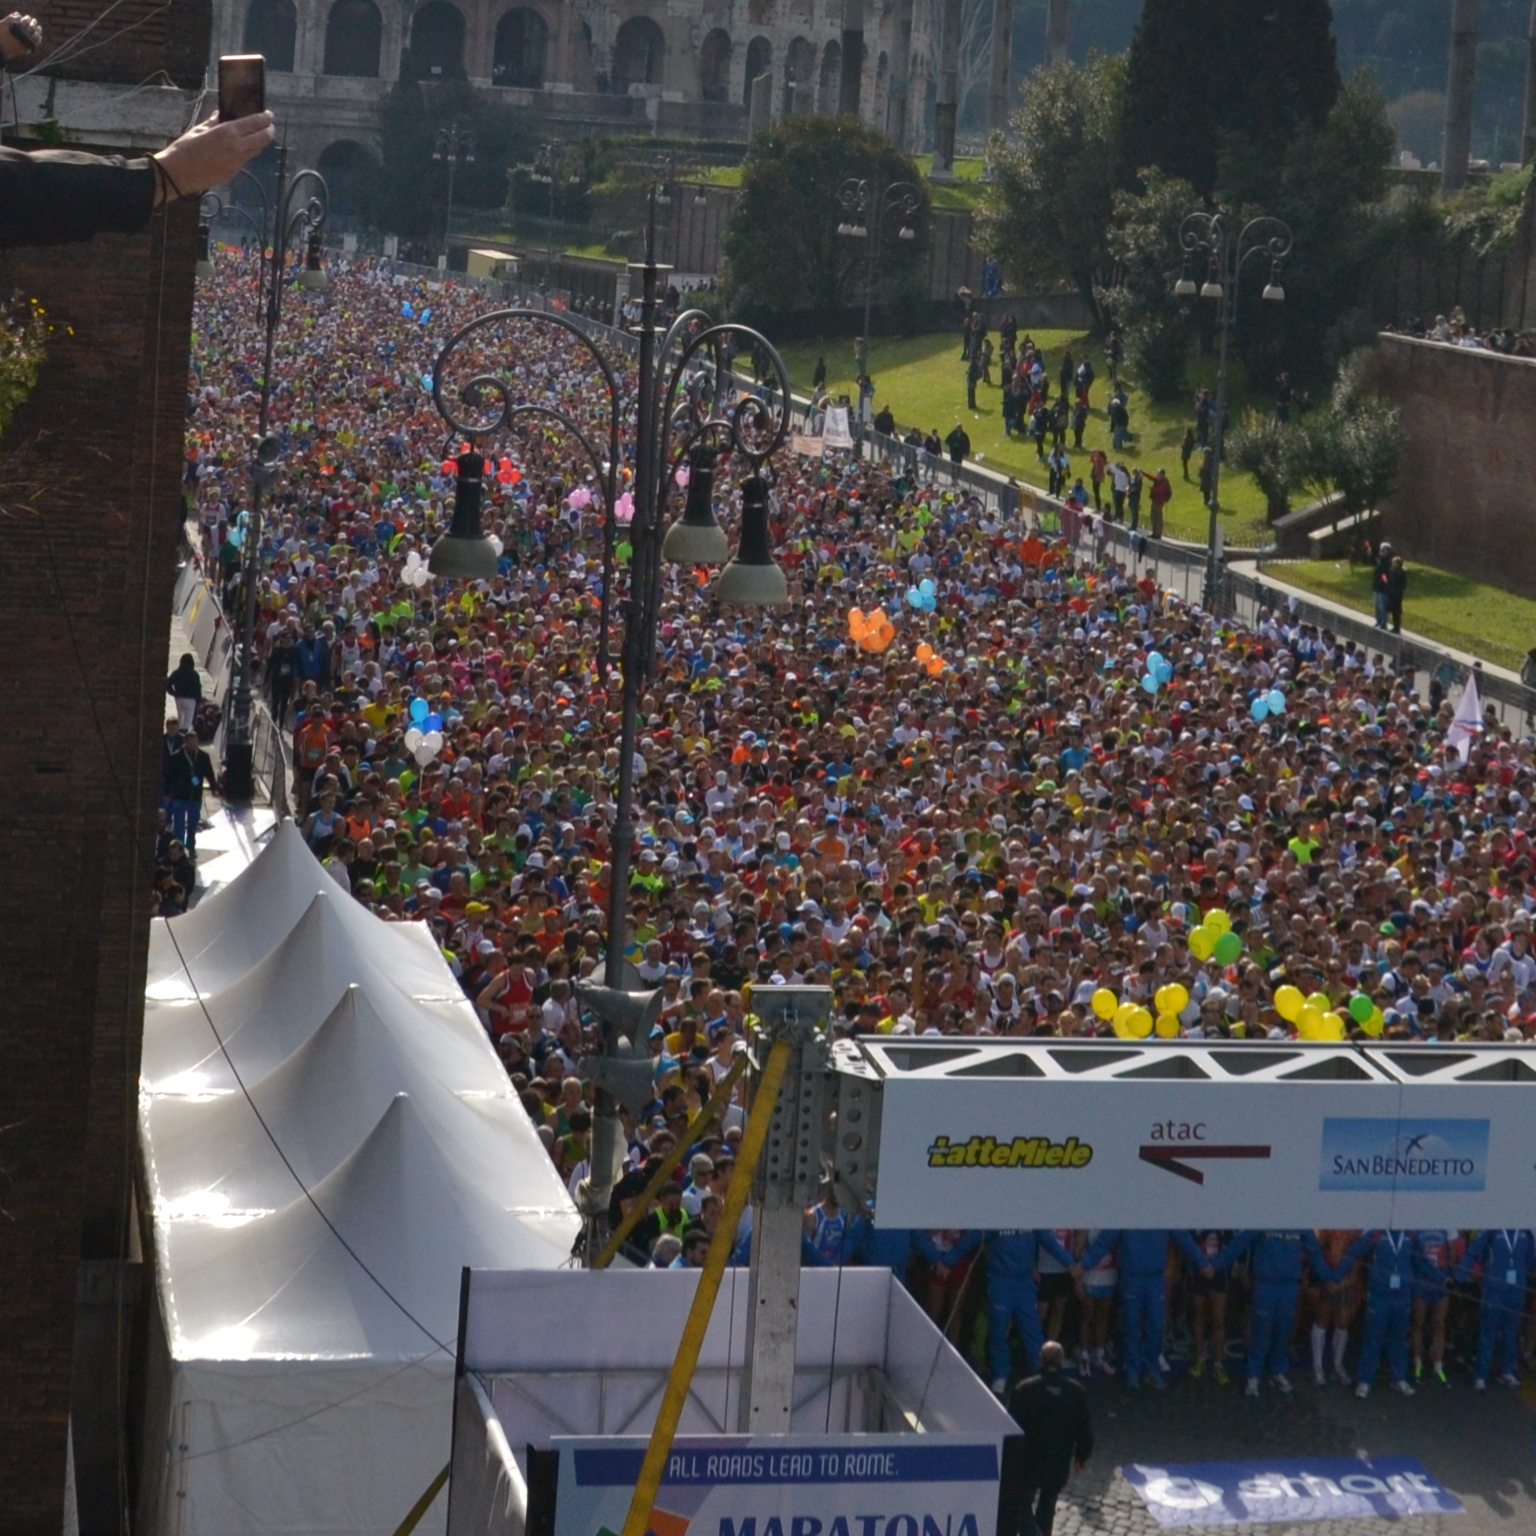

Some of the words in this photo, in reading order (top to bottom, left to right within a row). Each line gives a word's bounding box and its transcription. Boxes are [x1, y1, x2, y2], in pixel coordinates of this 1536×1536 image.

[1151, 1120, 1206, 1140] atac
[931, 1137, 1091, 1167] LatteMiele
[669, 1456, 700, 1478] ALL
[707, 1455, 763, 1477] ROADS
[770, 1454, 811, 1476] LEAD
[819, 1454, 839, 1476] TO
[845, 1453, 899, 1476] ROME.
[1238, 1471, 1440, 1499] smart
